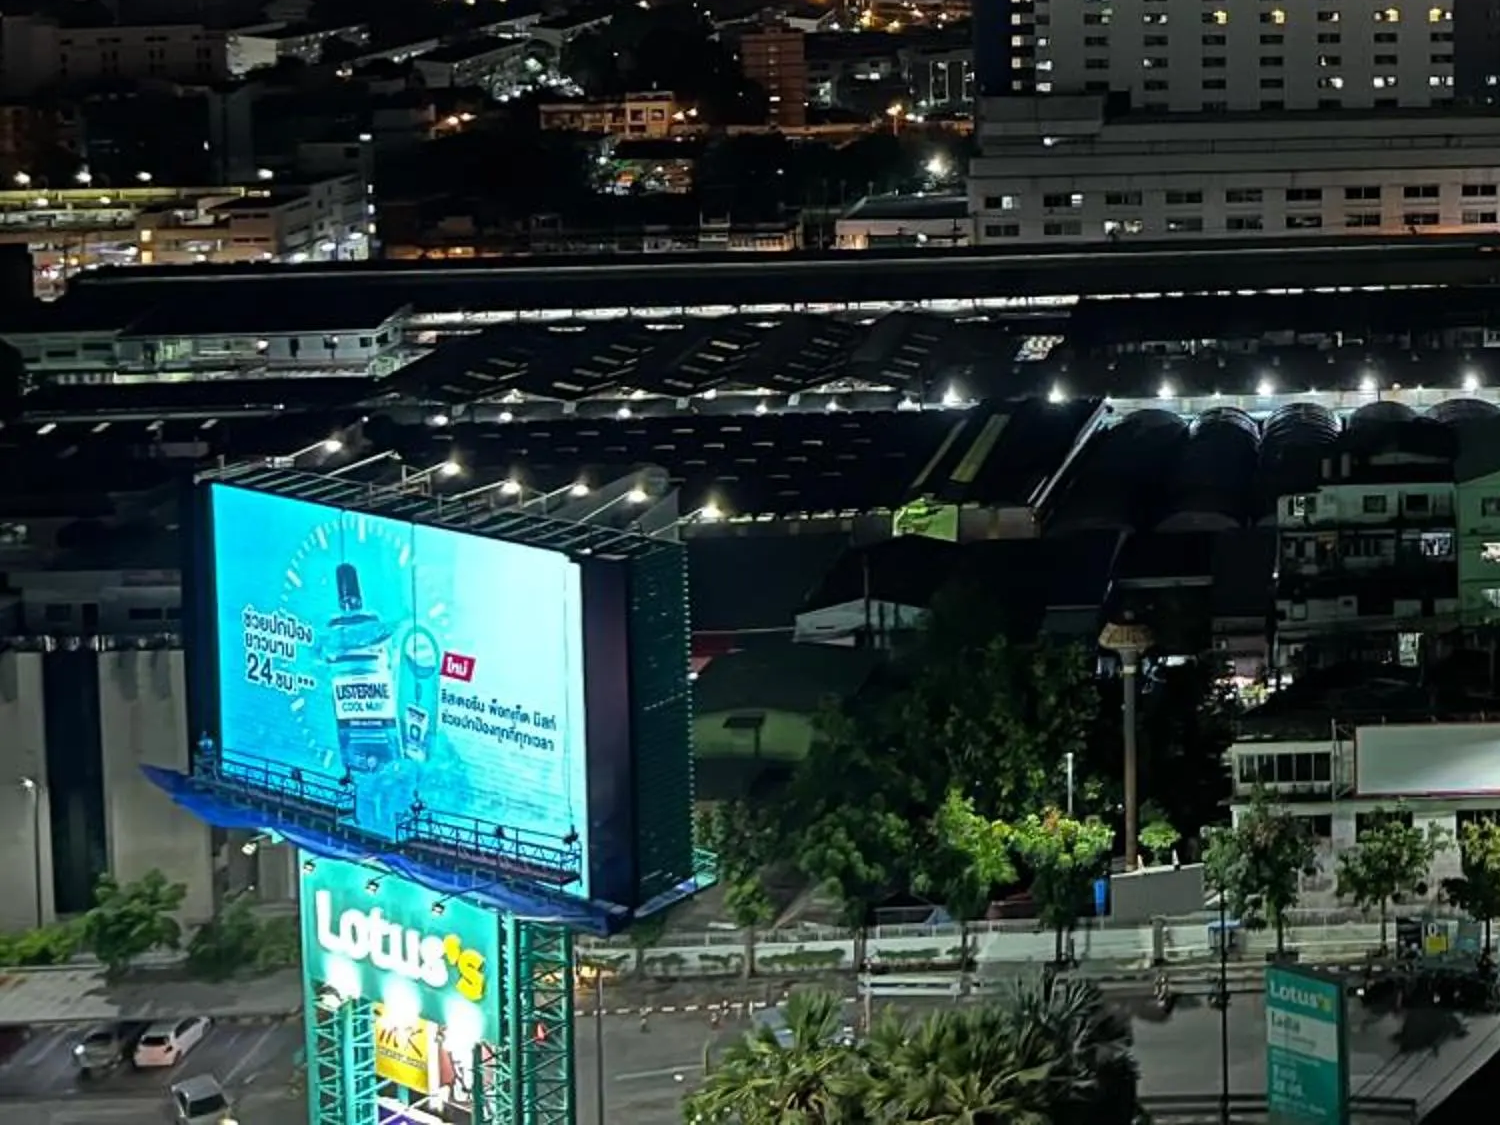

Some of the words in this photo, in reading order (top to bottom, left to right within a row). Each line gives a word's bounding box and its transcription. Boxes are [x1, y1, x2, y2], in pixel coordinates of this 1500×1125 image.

[243, 605, 313, 644] ช่วยปกป้อง
[245, 632, 295, 658] ยาวนาน
[247, 652, 273, 685] 24
[446, 655, 470, 677] ใหม่
[335, 682, 390, 701] LISTERINE
[341, 701, 364, 713] COOL
[315, 889, 486, 1002] Lotus's
